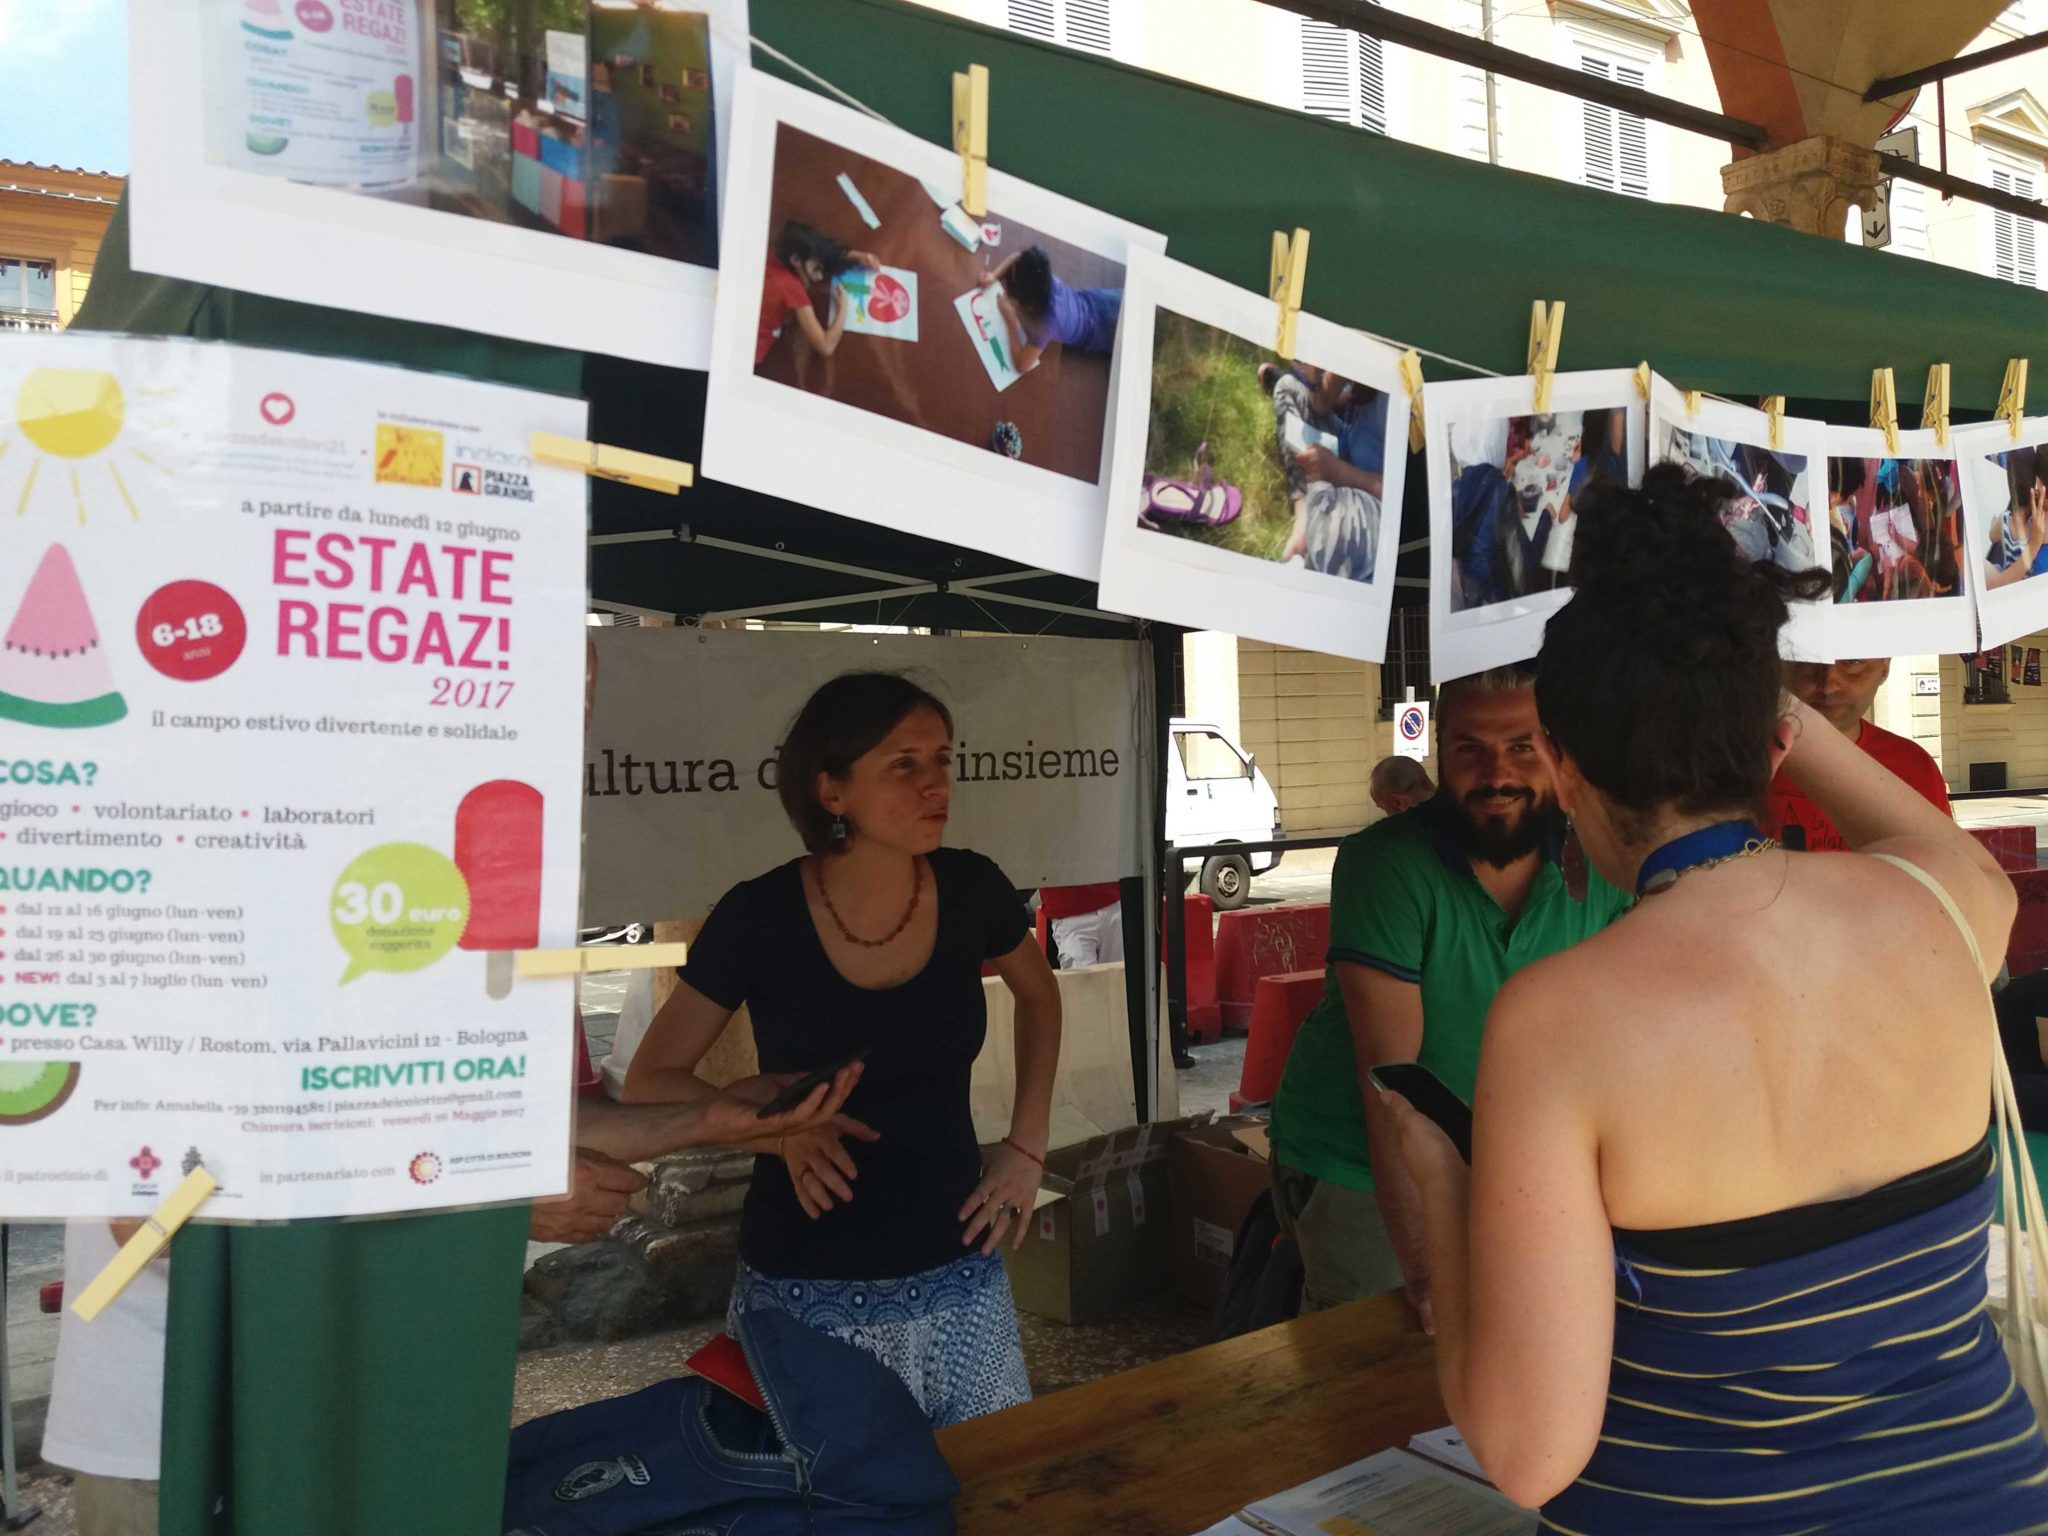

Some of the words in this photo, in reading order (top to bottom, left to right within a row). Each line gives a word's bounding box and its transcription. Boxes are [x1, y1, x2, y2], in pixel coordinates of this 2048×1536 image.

[241, 501, 255, 515] a
[259, 500, 333, 519] partire
[338, 505, 361, 523] da
[436, 521, 451, 534] 12
[457, 521, 521, 543] giugno
[273, 528, 514, 605] ESTATE
[152, 613, 223, 647] 6-18
[277, 599, 511, 671] REGAZ!
[429, 677, 515, 708] 2017
[152, 711, 164, 728] il
[170, 714, 240, 731] campo
[246, 715, 310, 733] estivo
[315, 716, 423, 737] divertente
[427, 727, 439, 737] e
[443, 723, 518, 741] solidale
[956, 740, 1120, 782] insieme
[94, 803, 233, 821] volontariato
[263, 806, 375, 825] laboratori
[16, 828, 163, 848] divertimento
[195, 833, 307, 850] creatività
[15, 902, 42, 915] dal
[48, 906, 62, 916] 12
[66, 903, 81, 916] al
[87, 905, 101, 916] 16
[106, 905, 162, 921] giugno
[335, 882, 404, 924] 30
[408, 908, 462, 923] euro
[16, 926, 42, 939] dal
[48, 930, 63, 941] 19
[67, 926, 83, 940] al
[88, 930, 104, 941] 23
[109, 929, 164, 944] giugno
[15, 949, 41, 962] dal
[68, 949, 84, 962] al
[88, 952, 106, 964] 30
[110, 950, 165, 966] giugno
[15, 972, 59, 984] NEW!
[66, 972, 92, 985] dal
[97, 975, 106, 987] 3
[110, 973, 125, 986] al
[130, 975, 138, 988] 7
[142, 973, 187, 989] luglio
[0, 1004, 97, 1028] OVE?
[11, 1036, 74, 1053] presso
[79, 1035, 126, 1050] Casa
[132, 1035, 183, 1055] Willy
[282, 1038, 311, 1052] via
[318, 1032, 419, 1053] Pallavicini
[424, 1036, 440, 1048] 12
[456, 1029, 528, 1047] Bologna
[302, 1060, 444, 1091] ISCRIVITI
[453, 1055, 526, 1082] ORA!
[93, 1099, 119, 1112] Per
